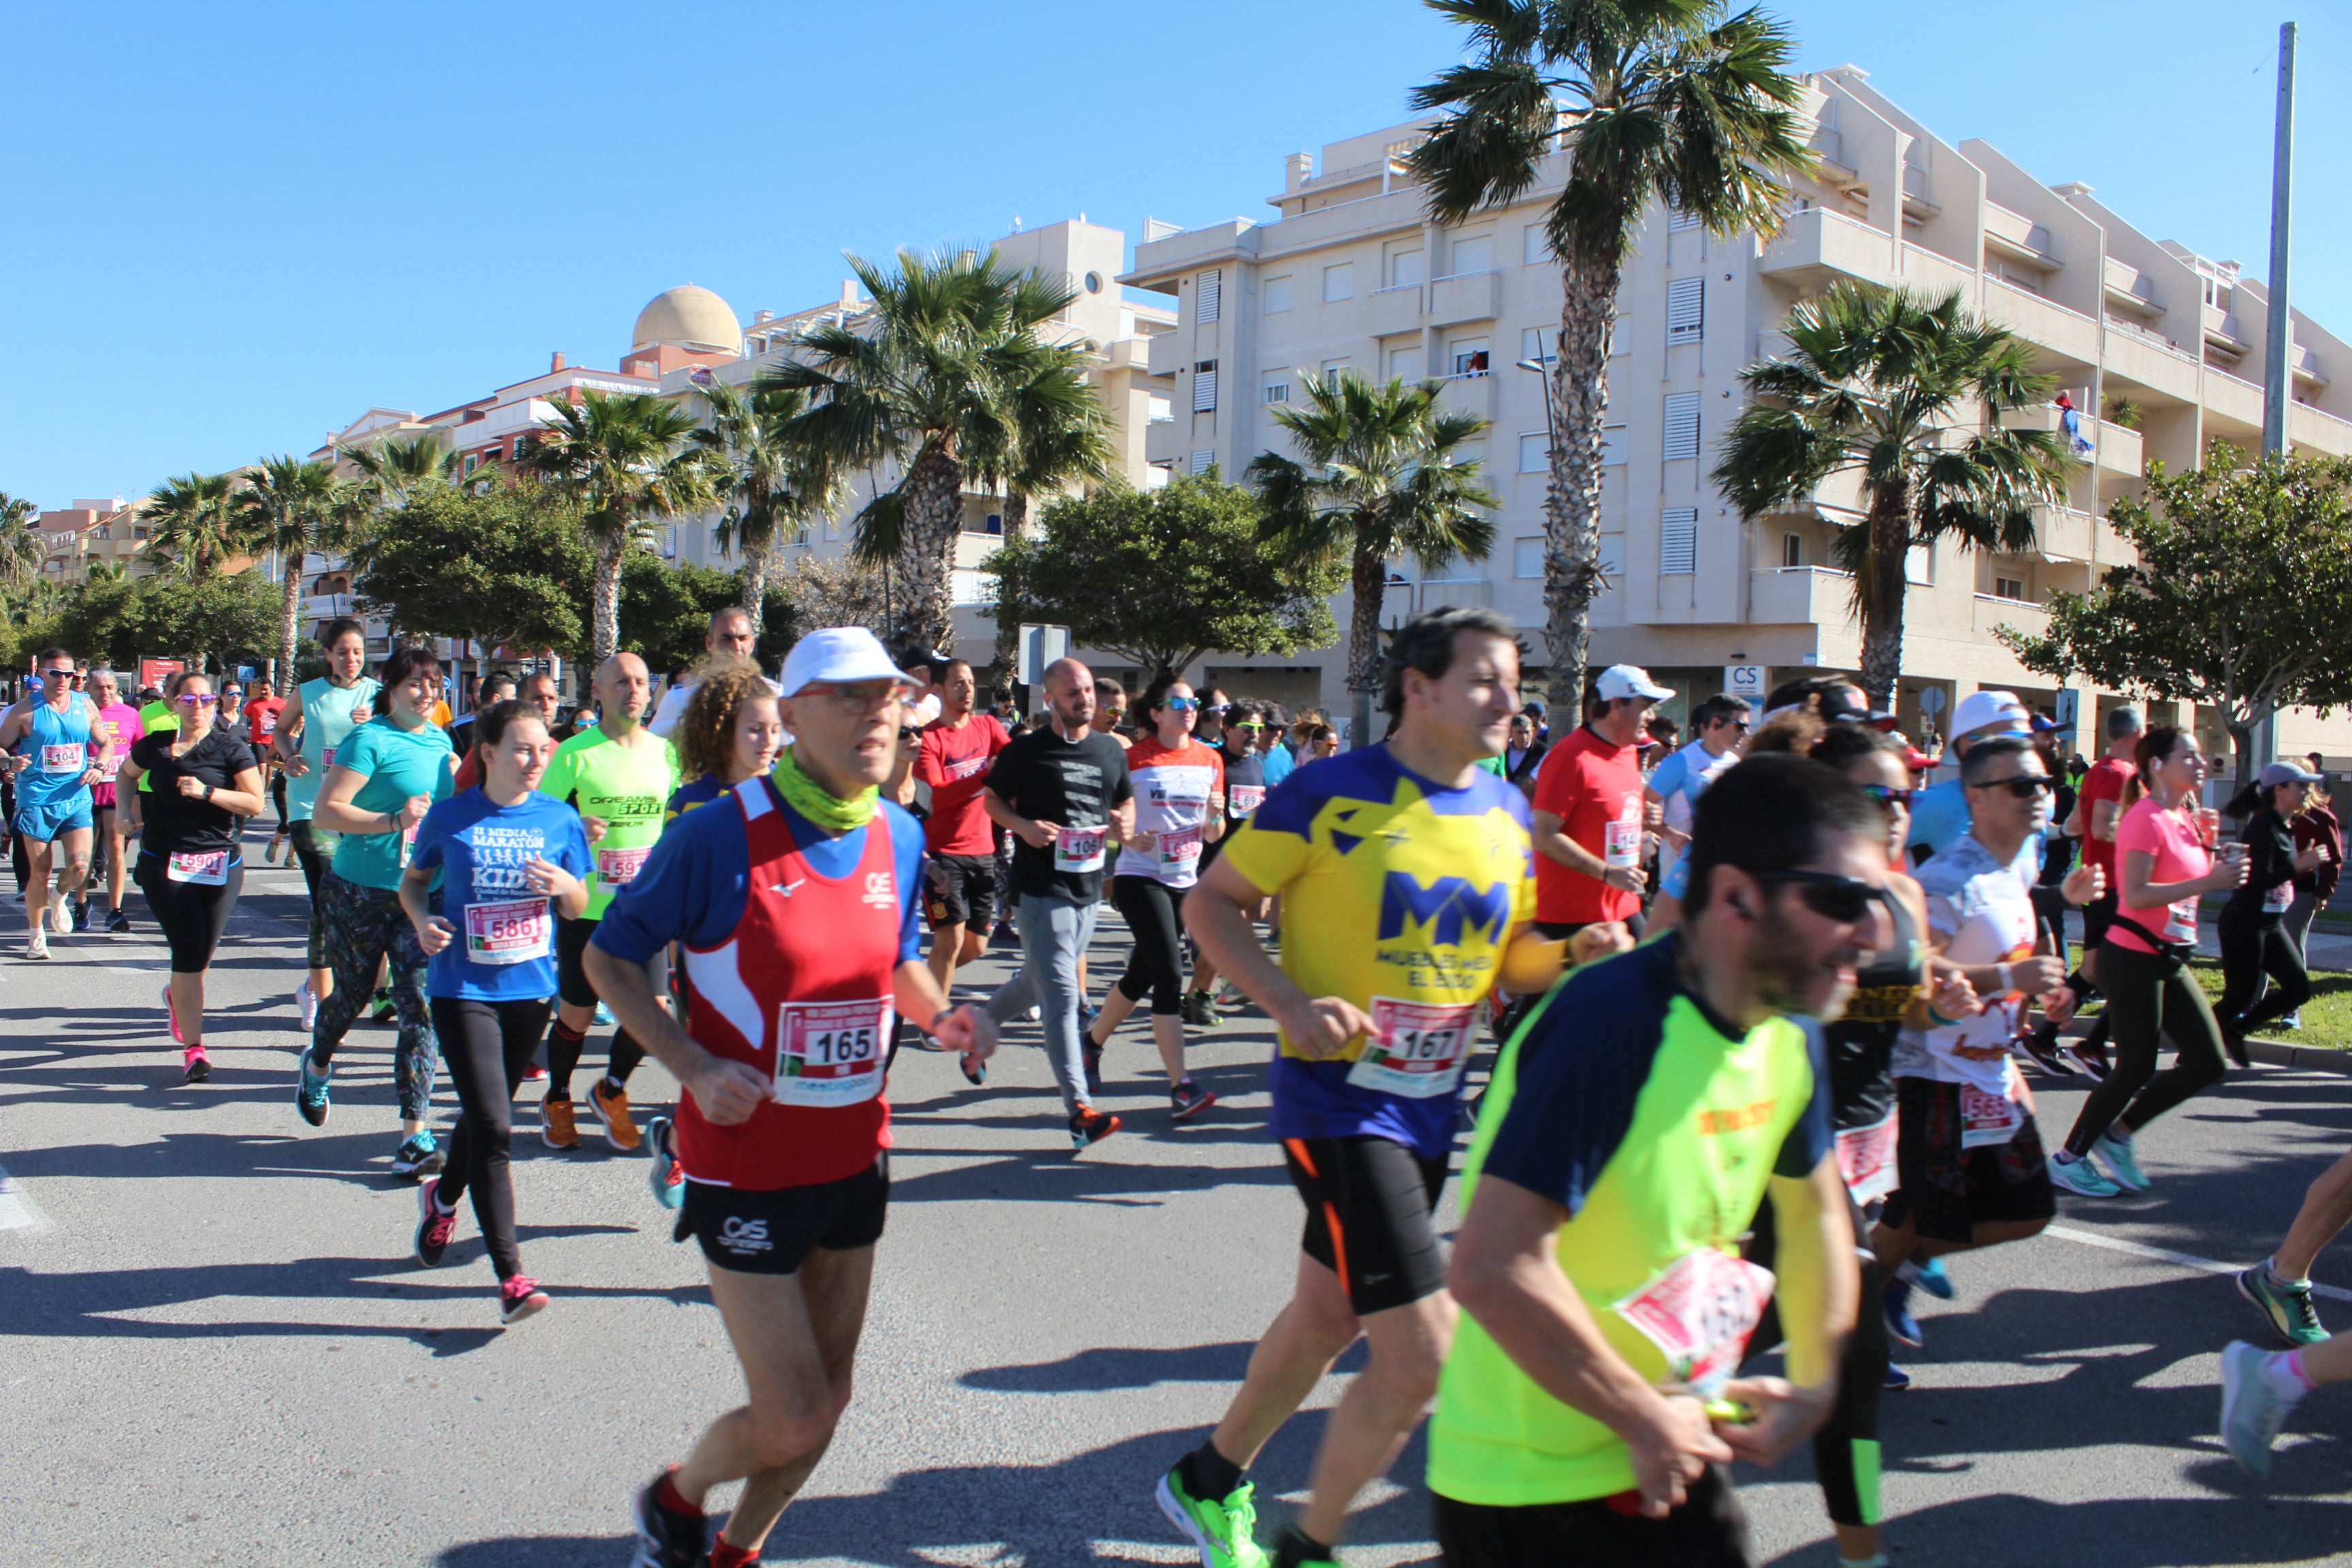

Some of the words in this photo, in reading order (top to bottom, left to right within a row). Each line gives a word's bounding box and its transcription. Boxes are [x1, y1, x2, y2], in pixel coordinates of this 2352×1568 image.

[1733, 667, 1757, 684] CS
[56, 752, 75, 761] 104
[590, 796, 658, 804] DREAMS
[1245, 796, 1256, 805] 69
[474, 827, 485, 835] II
[487, 828, 528, 837] MEDIA
[472, 835, 544, 849] MARATÓN
[1075, 840, 1098, 853] 106
[187, 854, 214, 868] 590
[472, 867, 529, 889] KID
[491, 917, 533, 938] 586
[817, 1029, 870, 1062] 165
[1405, 1030, 1455, 1058] 167
